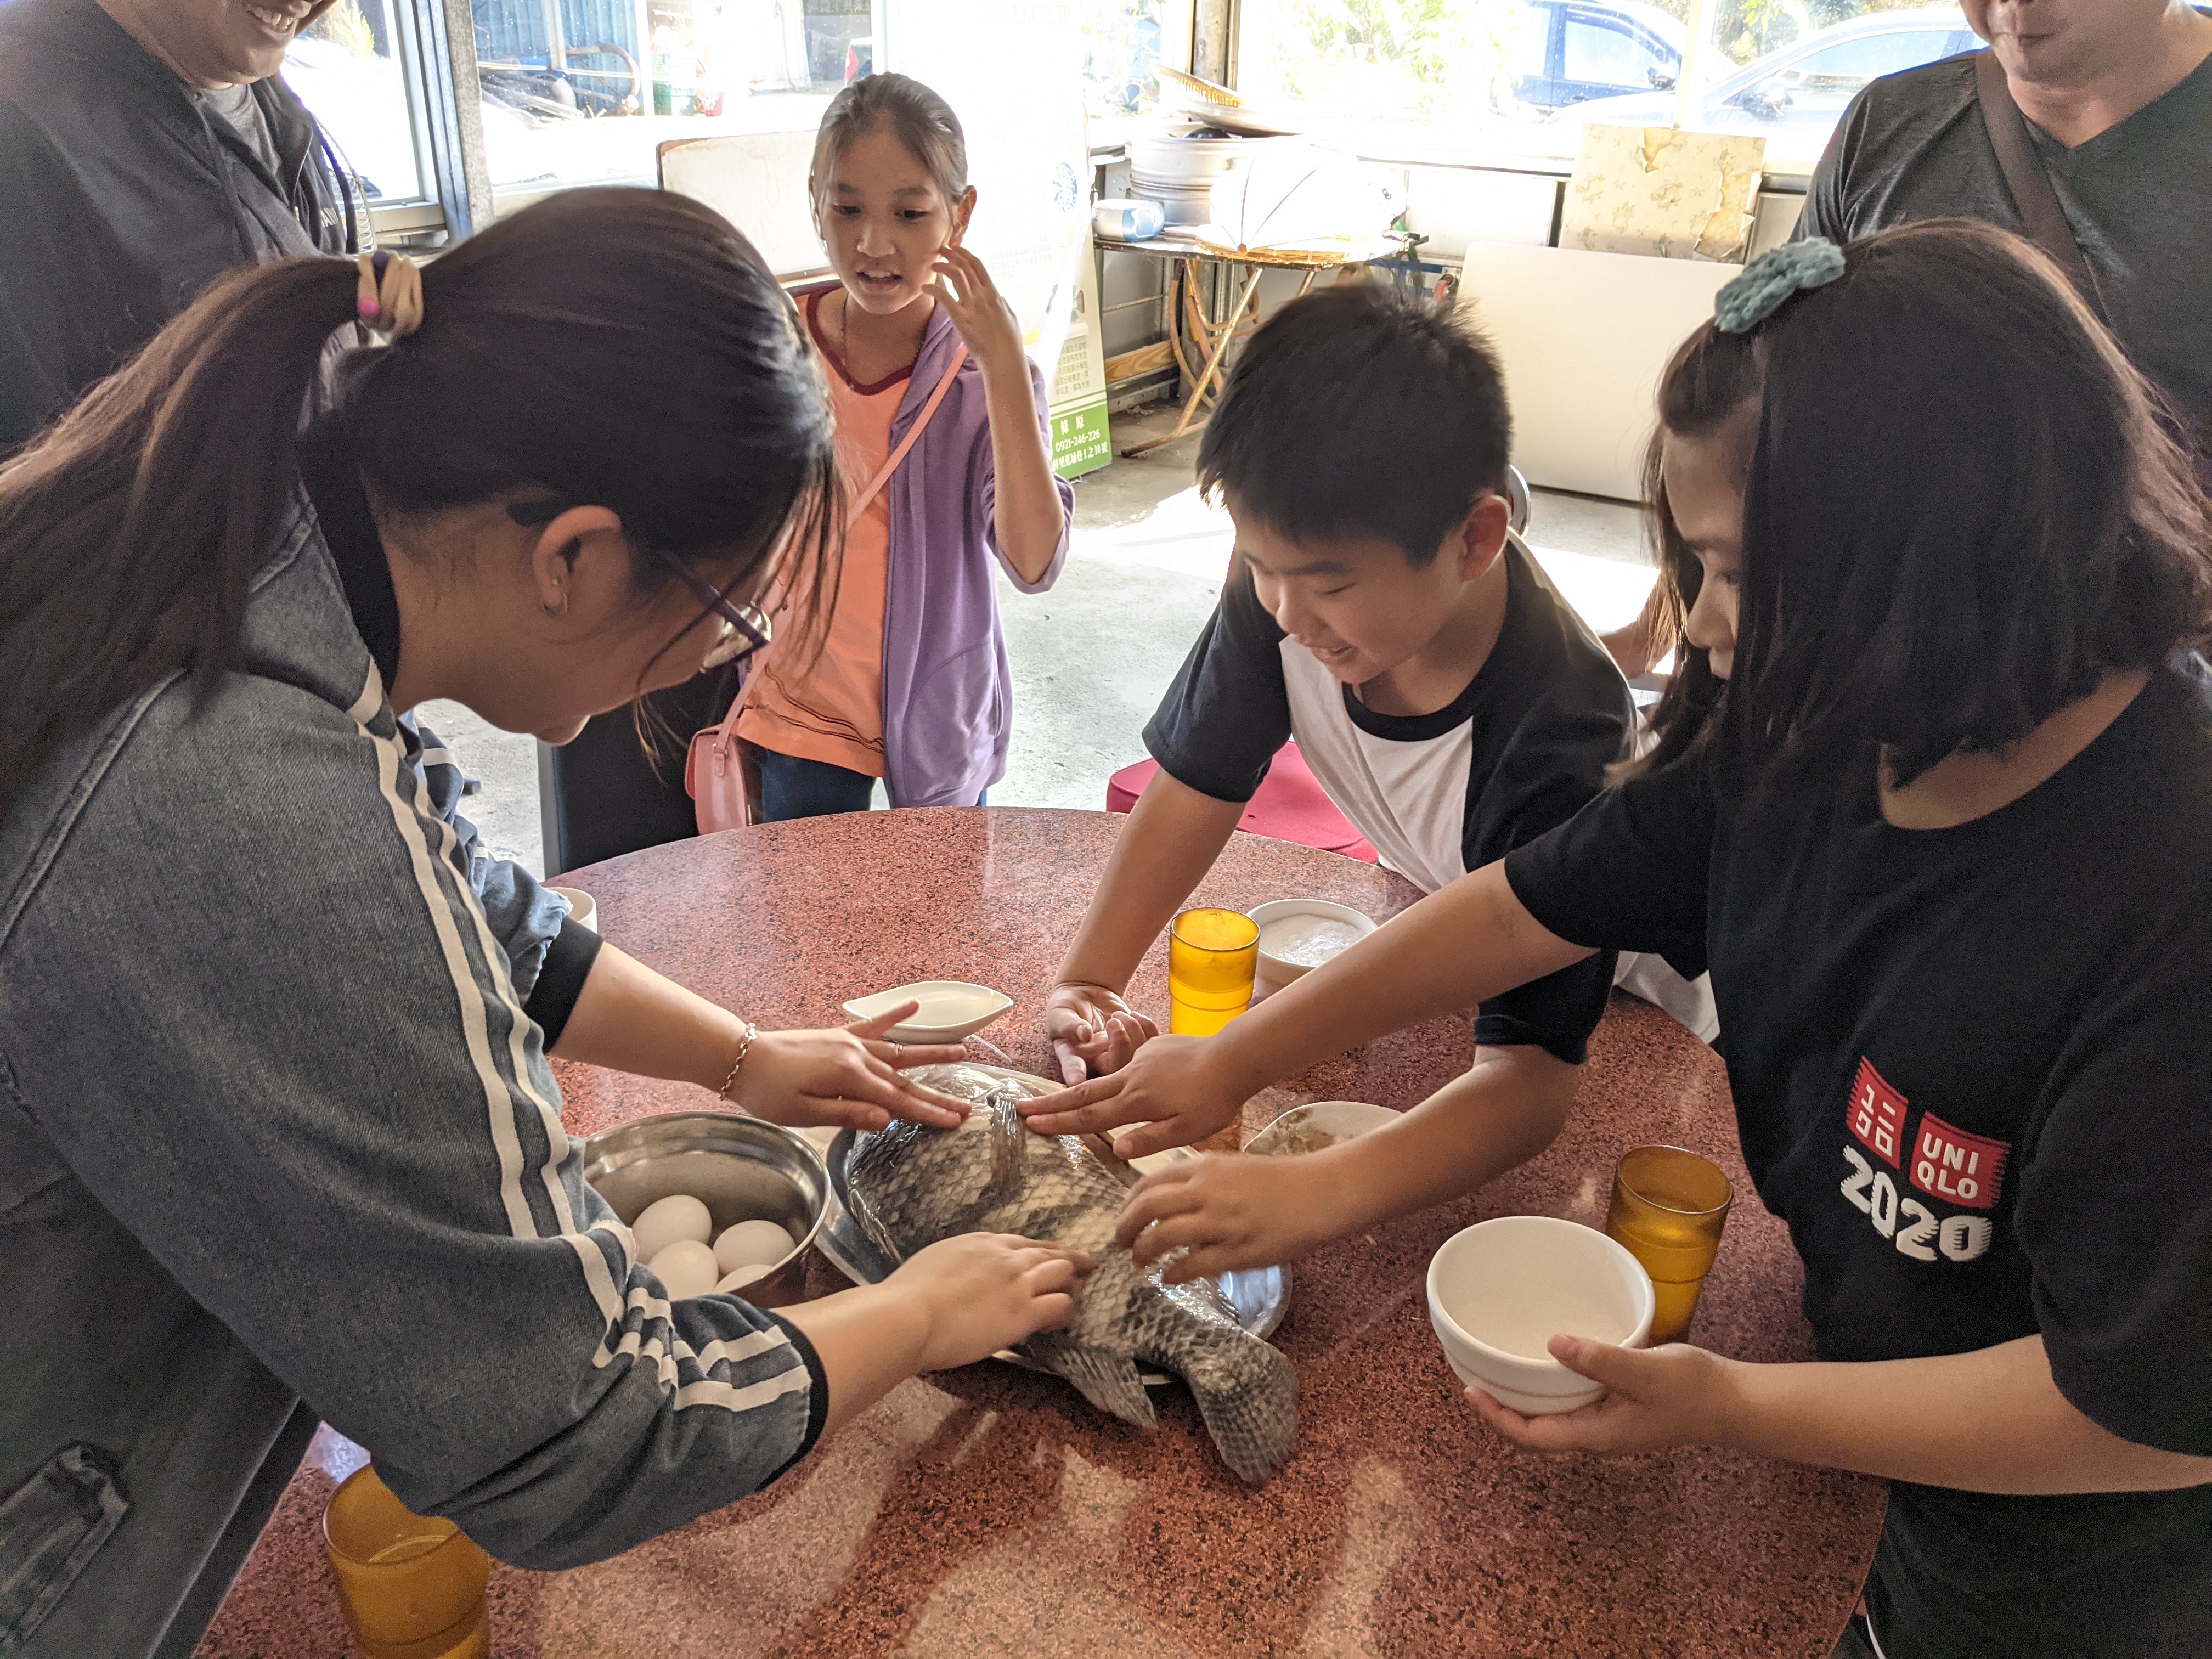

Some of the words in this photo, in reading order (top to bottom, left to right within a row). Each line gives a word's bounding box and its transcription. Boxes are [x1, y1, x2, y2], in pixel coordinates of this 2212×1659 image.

[1055, 428, 1101, 452] 0921-246-226
[1922, 1133, 1979, 1175] UNI
[1917, 1161, 1979, 1200] QLO
[1839, 1144, 1993, 1262] 2020
